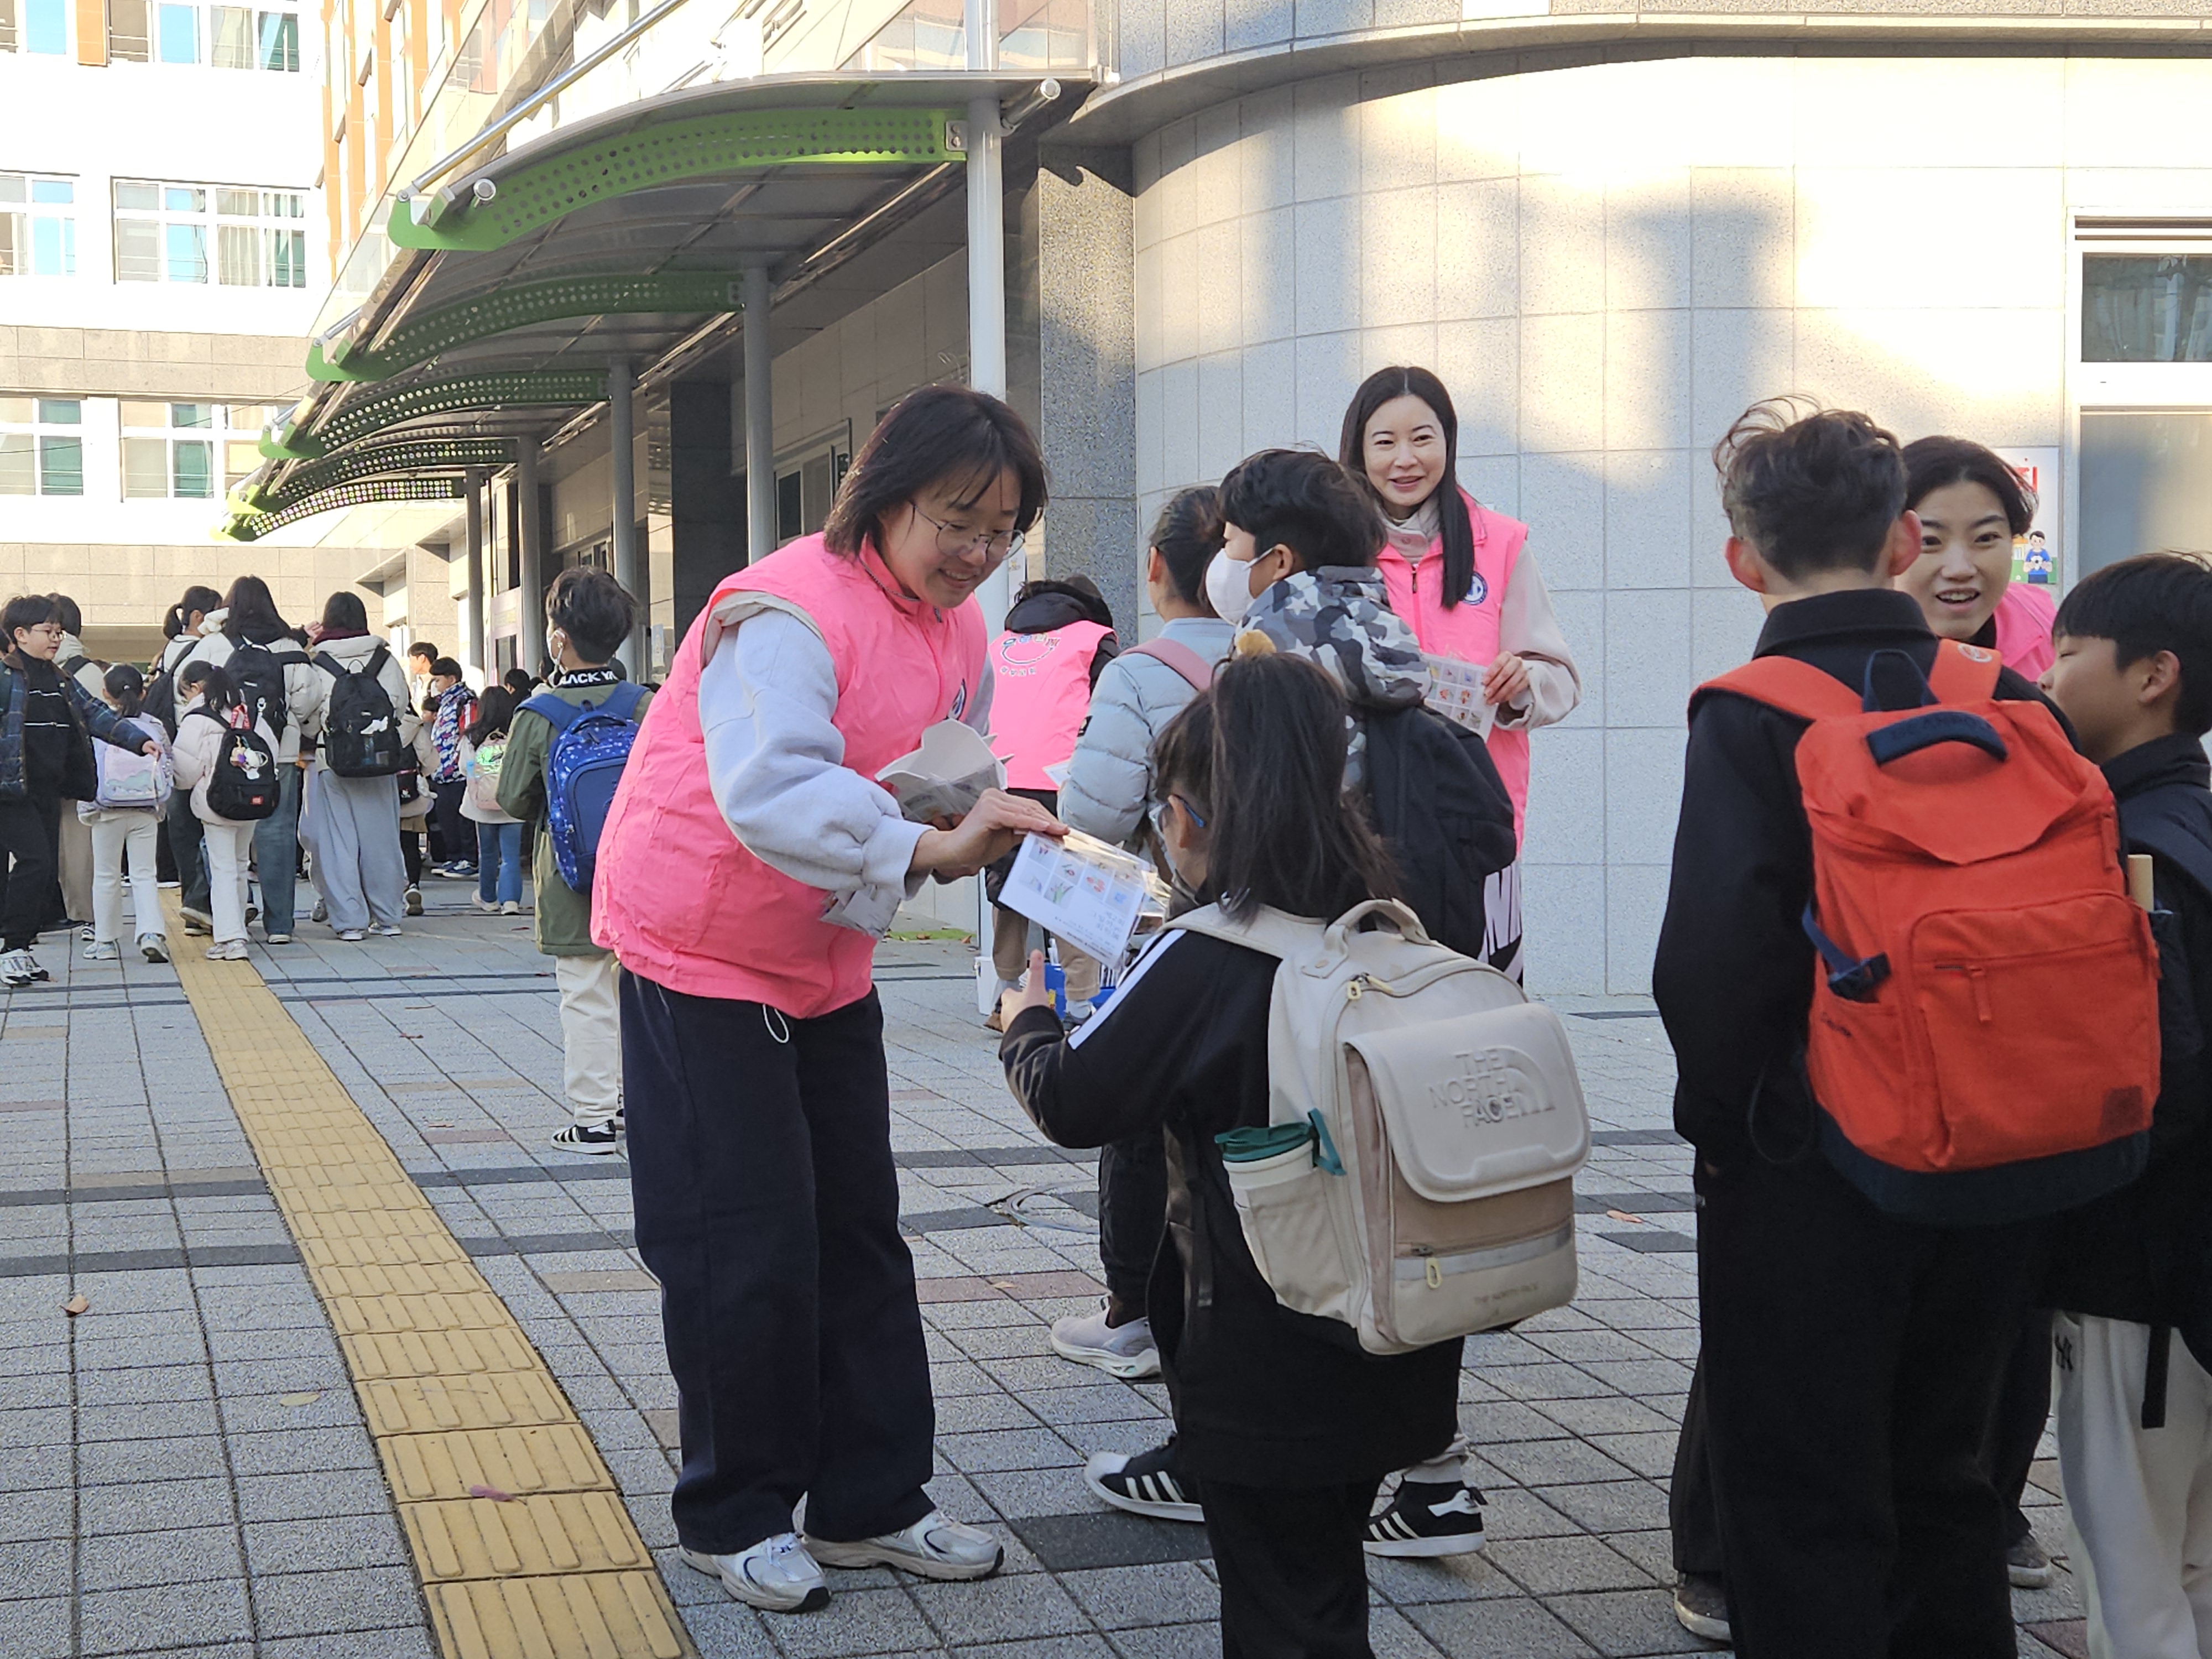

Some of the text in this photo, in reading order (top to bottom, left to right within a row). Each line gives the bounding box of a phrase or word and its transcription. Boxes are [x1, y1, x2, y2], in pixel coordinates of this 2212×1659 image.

[1453, 1048, 1504, 1076] THE
[1426, 1073, 1511, 1108] NORTH
[1462, 1094, 1519, 1129] FACE
